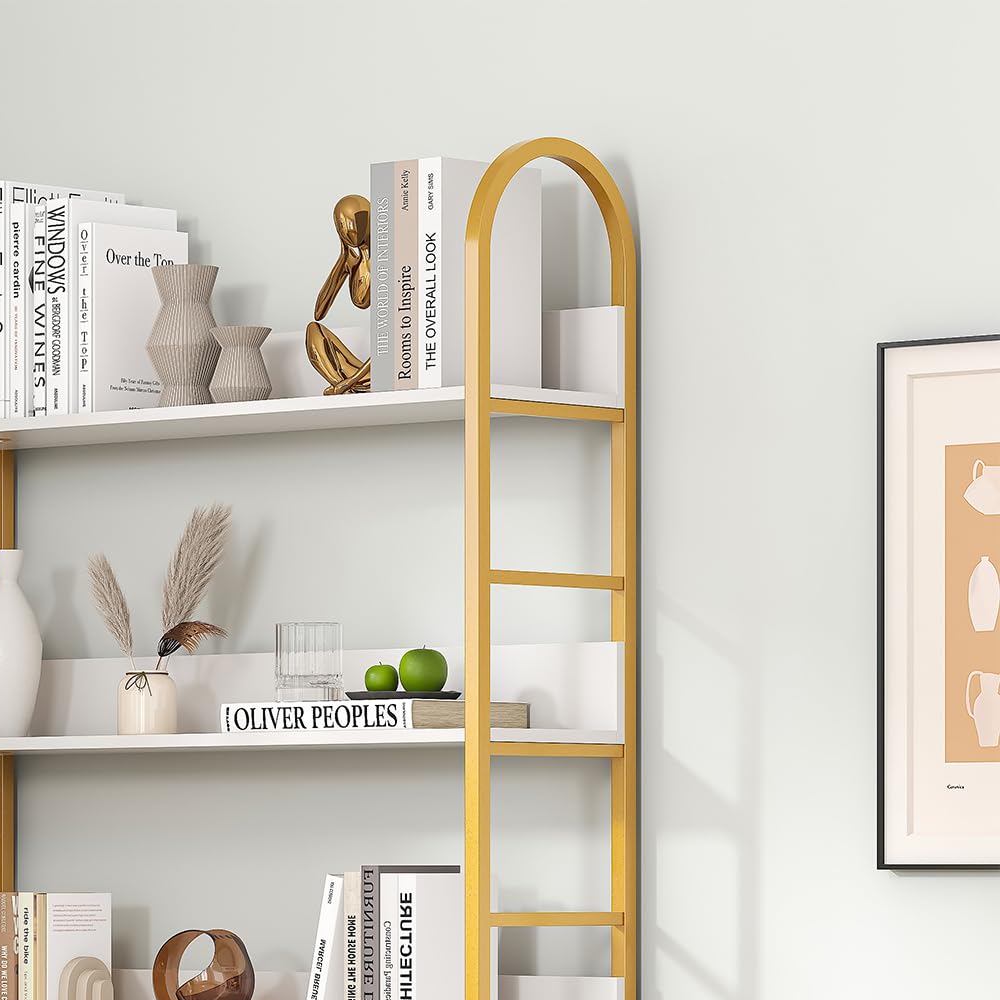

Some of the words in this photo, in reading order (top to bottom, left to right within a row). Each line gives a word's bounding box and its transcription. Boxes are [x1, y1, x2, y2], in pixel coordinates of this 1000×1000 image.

[401, 169, 410, 188] Kelly
[401, 190, 409, 211] Annie
[12, 222, 20, 257] pierre
[377, 197, 389, 261] INTERIORS
[34, 236, 45, 291] FINE
[47, 204, 66, 294] WINDOWS
[106, 248, 132, 266] Over
[134, 251, 151, 268] the
[425, 232, 436, 271] LOOK
[377, 266, 389, 281] OF
[398, 265, 415, 311] Inspire
[377, 284, 389, 329] WORLD
[399, 316, 411, 329] to
[425, 273, 436, 338] OVERALL
[34, 303, 45, 388] WINES
[377, 332, 389, 356] THE
[398, 333, 412, 380] Rooms
[425, 343, 436, 370] THE
[233, 706, 307, 731] OLIVER
[312, 703, 398, 729] PEOPLES
